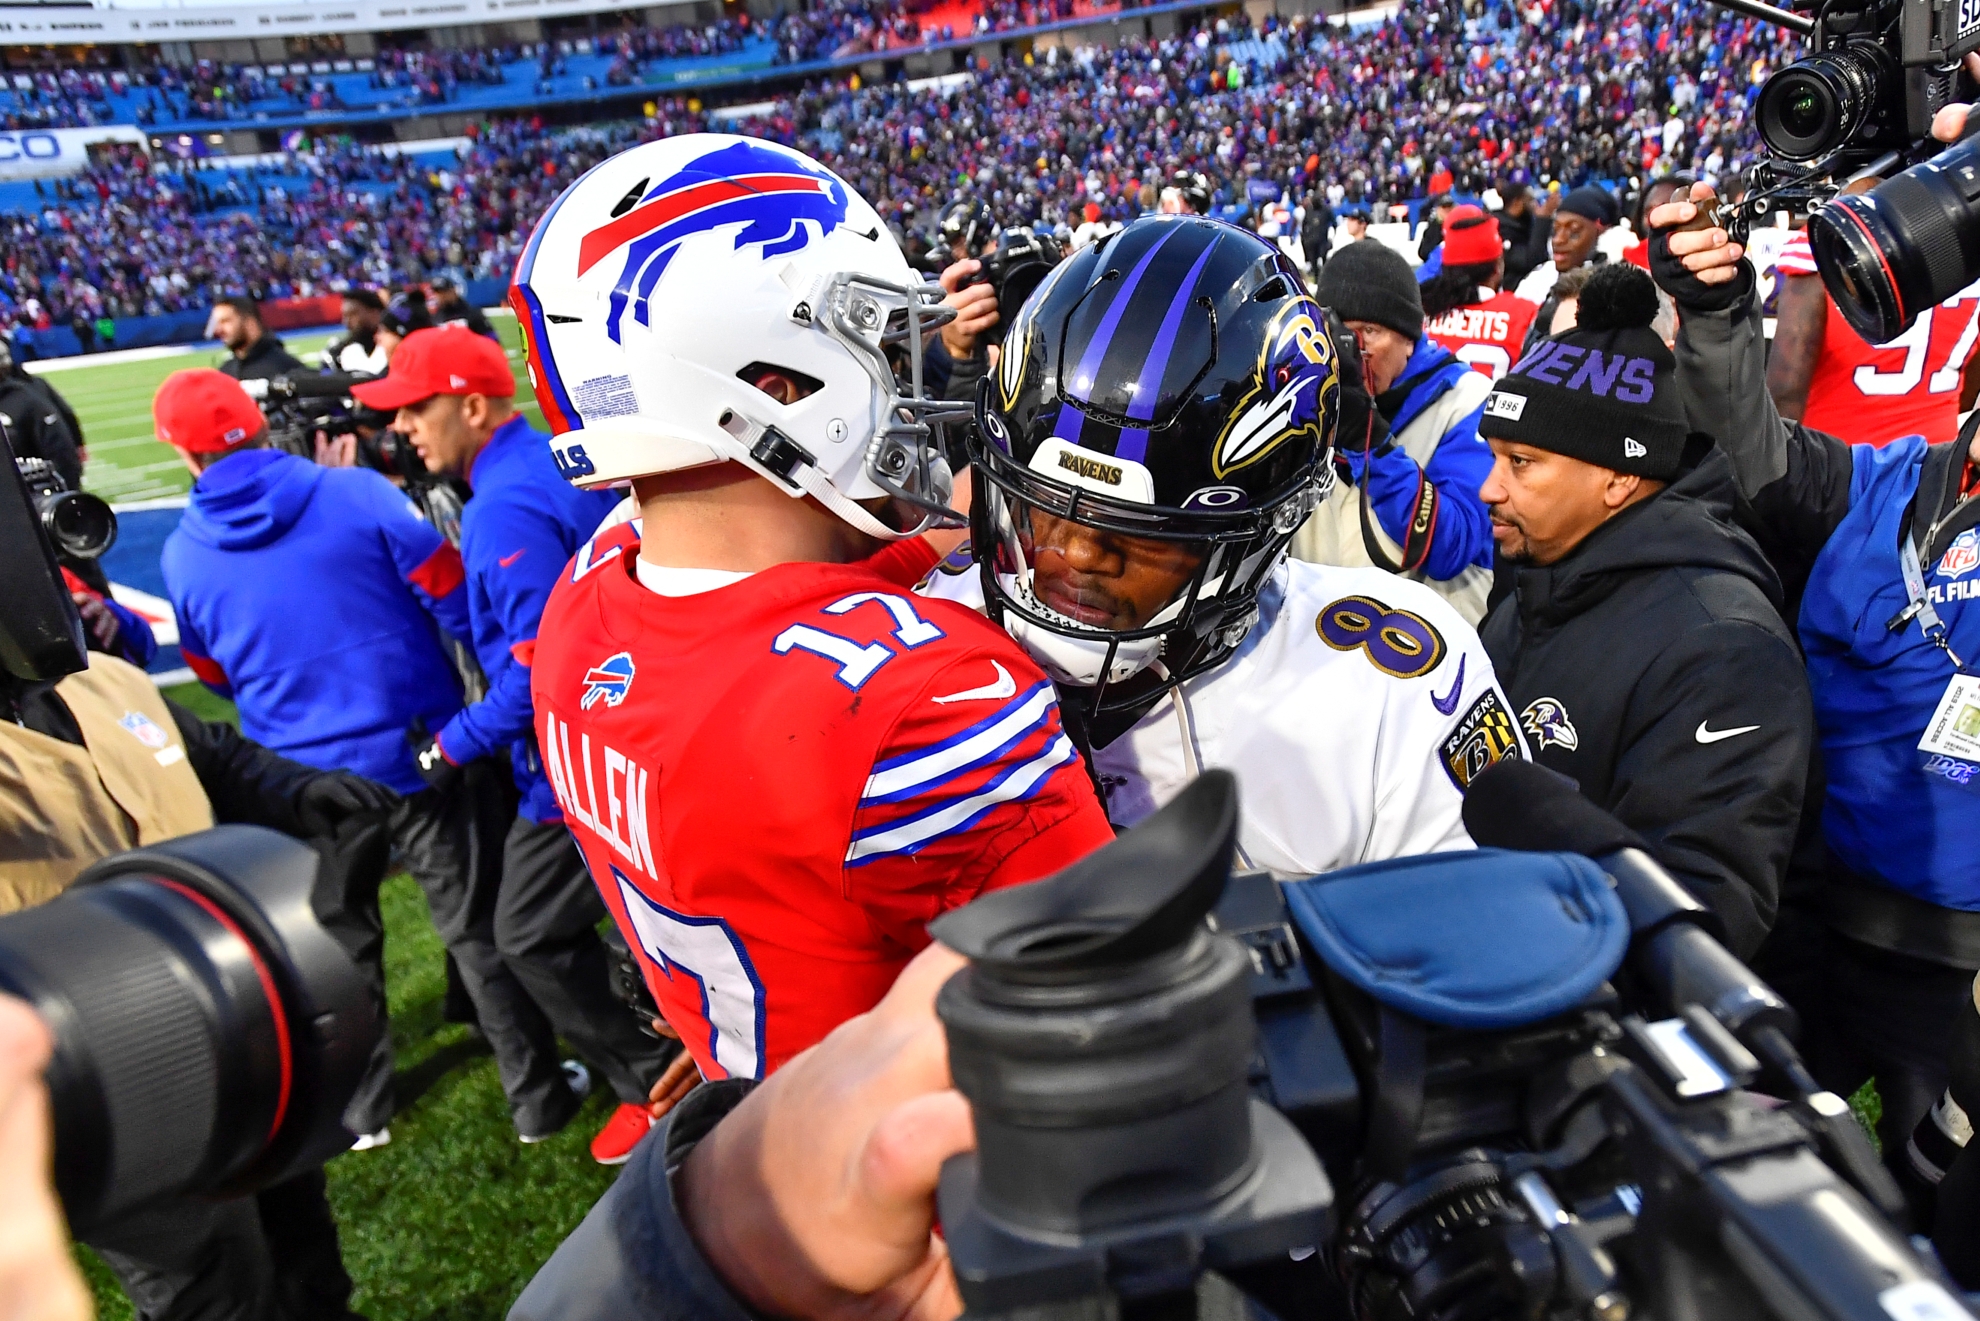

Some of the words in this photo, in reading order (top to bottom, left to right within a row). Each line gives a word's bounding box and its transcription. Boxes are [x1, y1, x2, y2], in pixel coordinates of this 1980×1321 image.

[1498, 398, 1518, 412] 1996
[1058, 450, 1123, 486] RAVENS
[1414, 480, 1434, 534] Canon
[1941, 548, 1975, 569] NFL
[1927, 584, 1946, 604] FL
[770, 591, 948, 693] 17
[1316, 594, 1448, 680] 8
[1446, 693, 1496, 755] RAVENS
[1944, 704, 1955, 716] ALL
[1930, 716, 1948, 744] ACCESS
[547, 711, 658, 882] ALLEN
